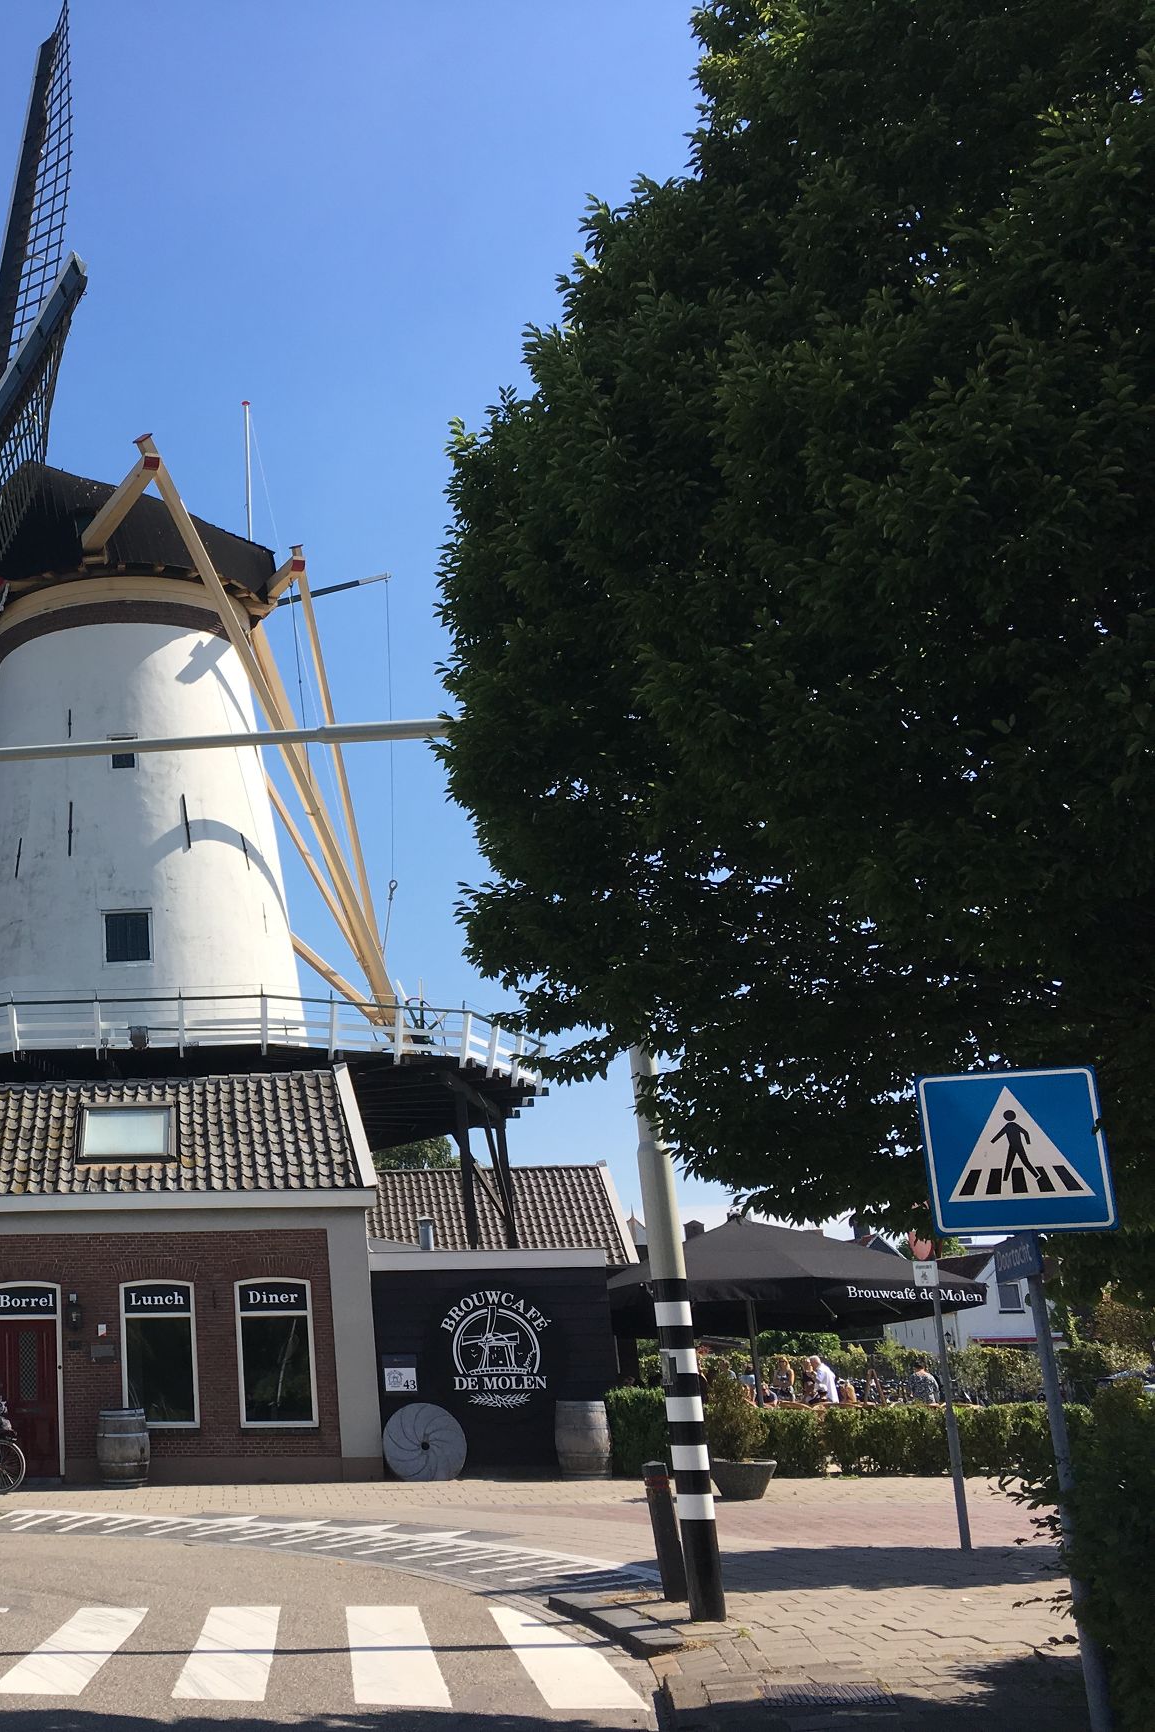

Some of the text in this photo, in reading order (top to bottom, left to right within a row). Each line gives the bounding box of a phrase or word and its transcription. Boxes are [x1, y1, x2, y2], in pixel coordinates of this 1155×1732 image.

[130, 1291, 185, 1306] Lunch
[247, 1290, 299, 1304] Diner
[846, 1285, 984, 1303] Brouwcafé de Molen
[440, 1290, 552, 1334] BROUWCAFÉ
[403, 1379, 417, 1390] 43
[453, 1375, 548, 1391] DE MOLEN
